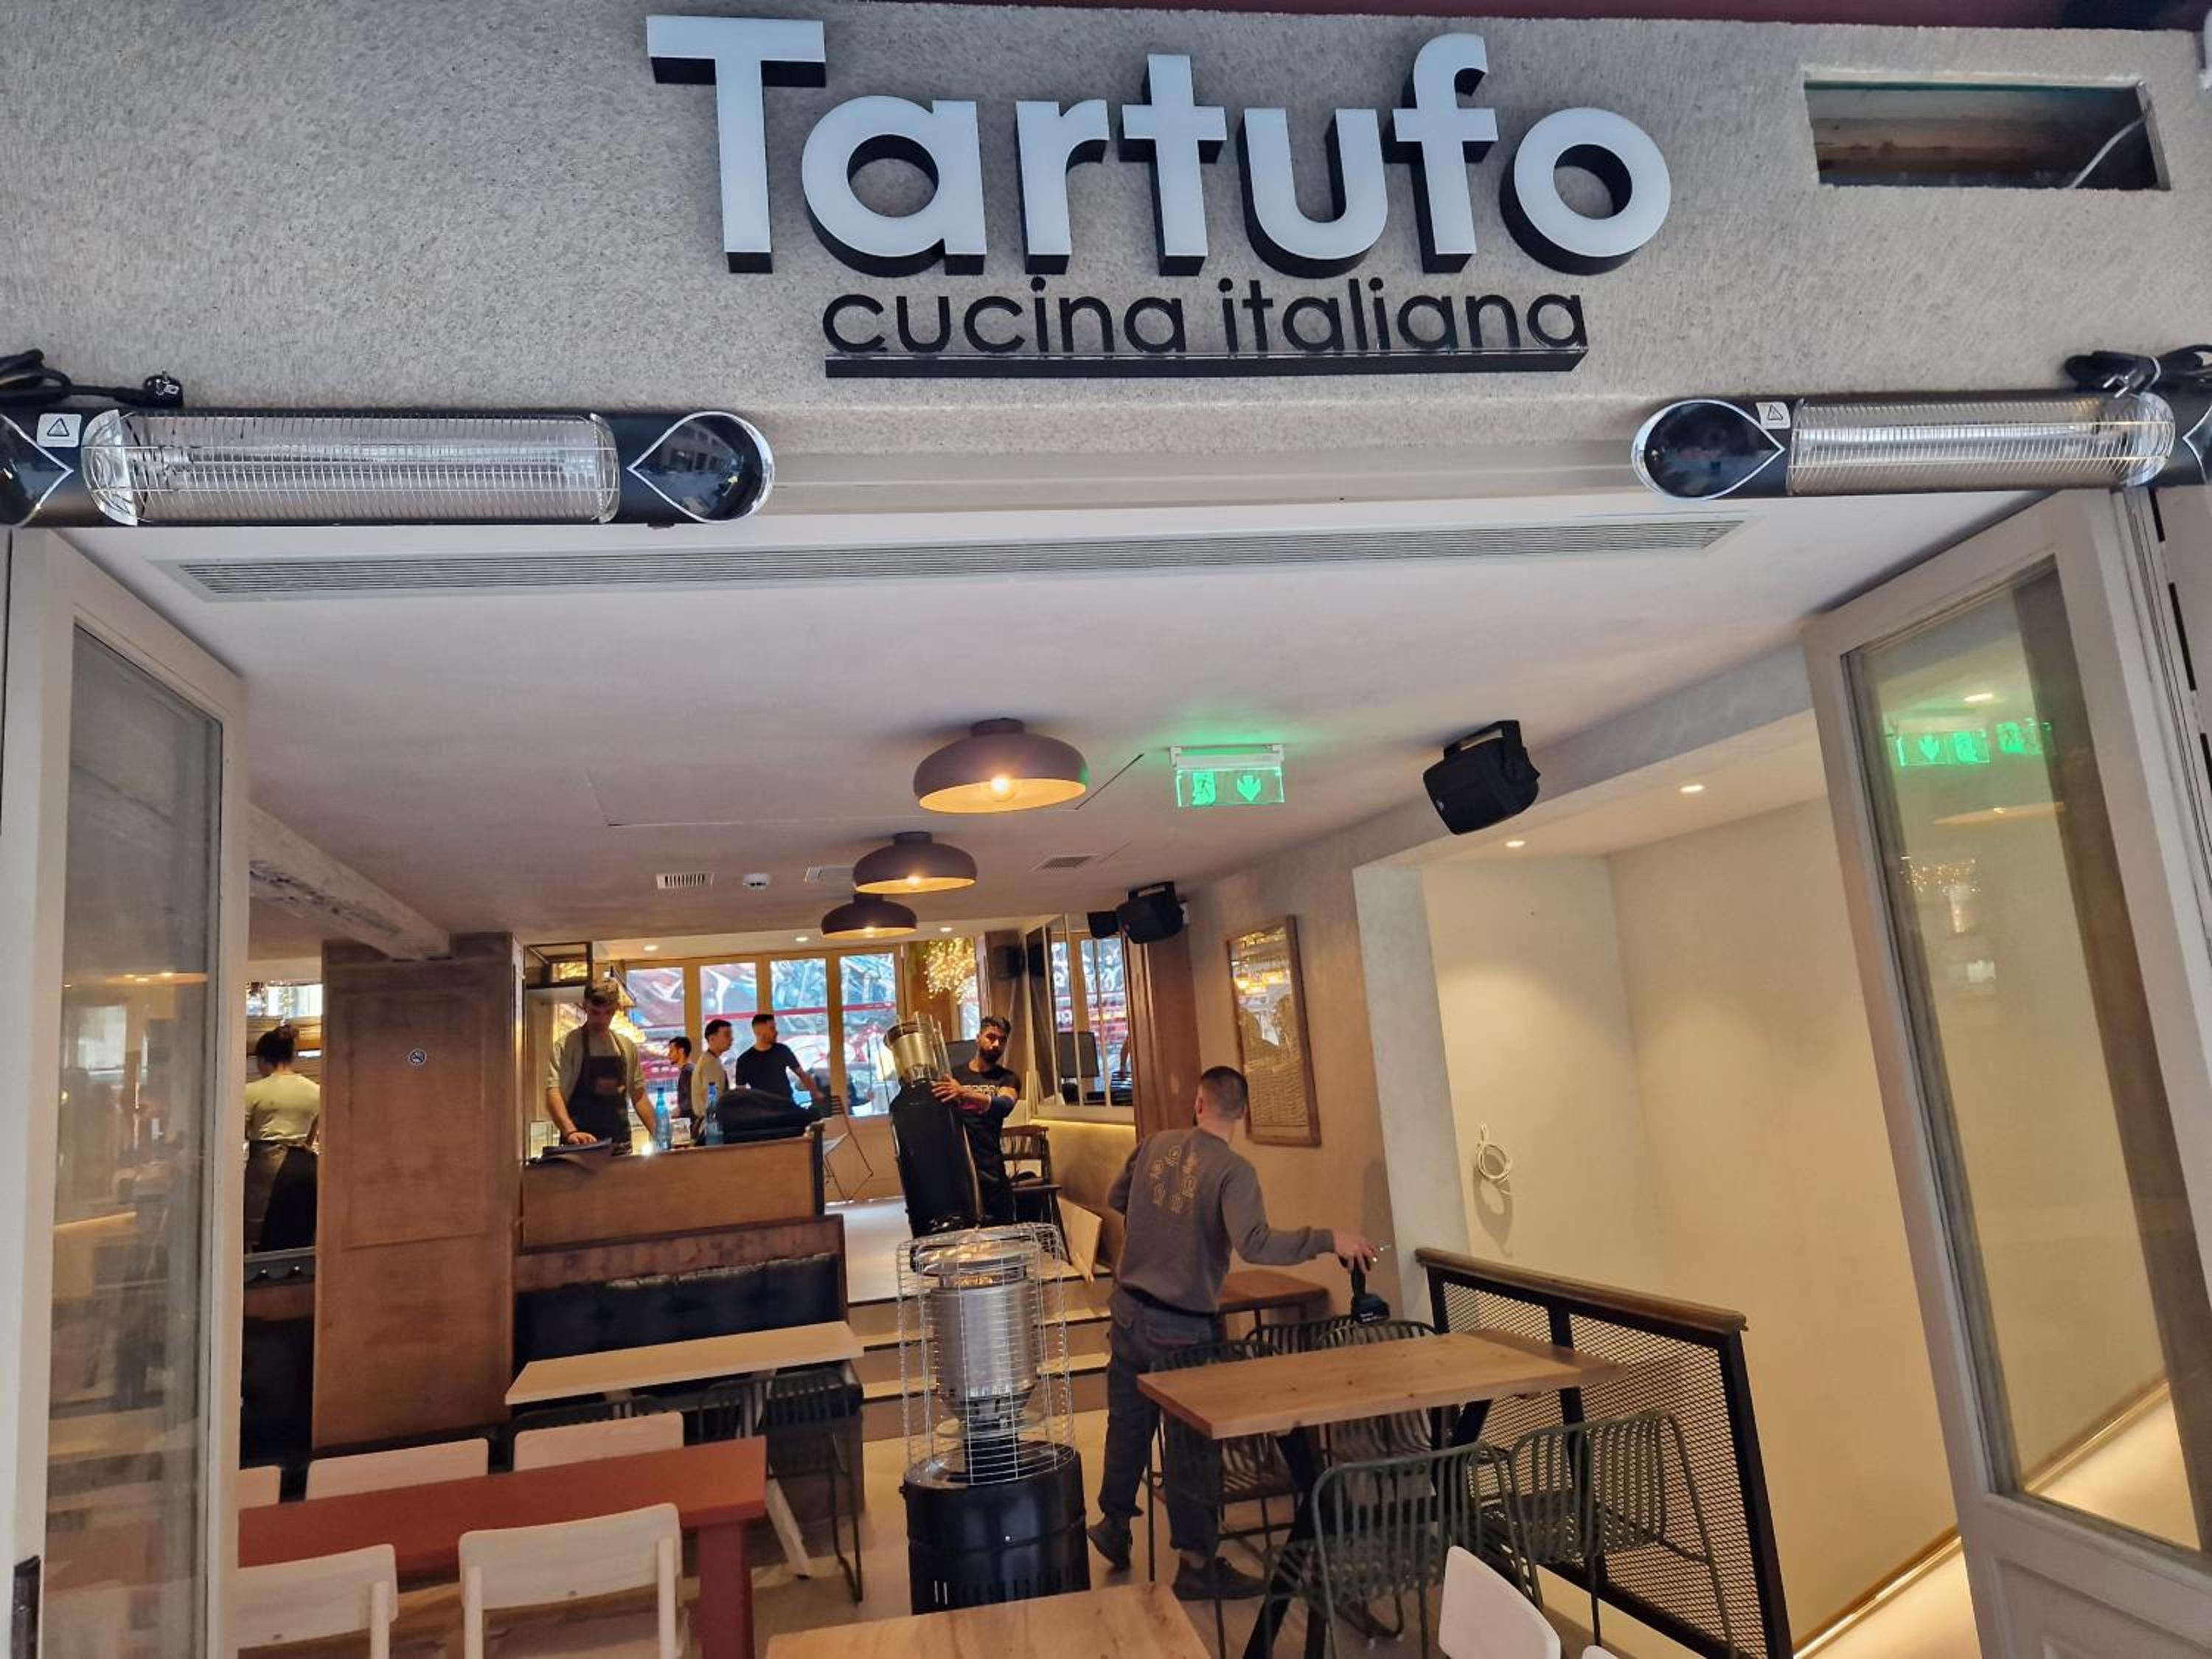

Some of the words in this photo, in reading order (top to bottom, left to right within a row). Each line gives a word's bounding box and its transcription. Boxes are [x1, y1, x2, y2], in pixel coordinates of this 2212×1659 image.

[646, 15, 1672, 276] Tartufo
[822, 276, 1186, 353] cucina
[1217, 277, 1587, 354] italiana
